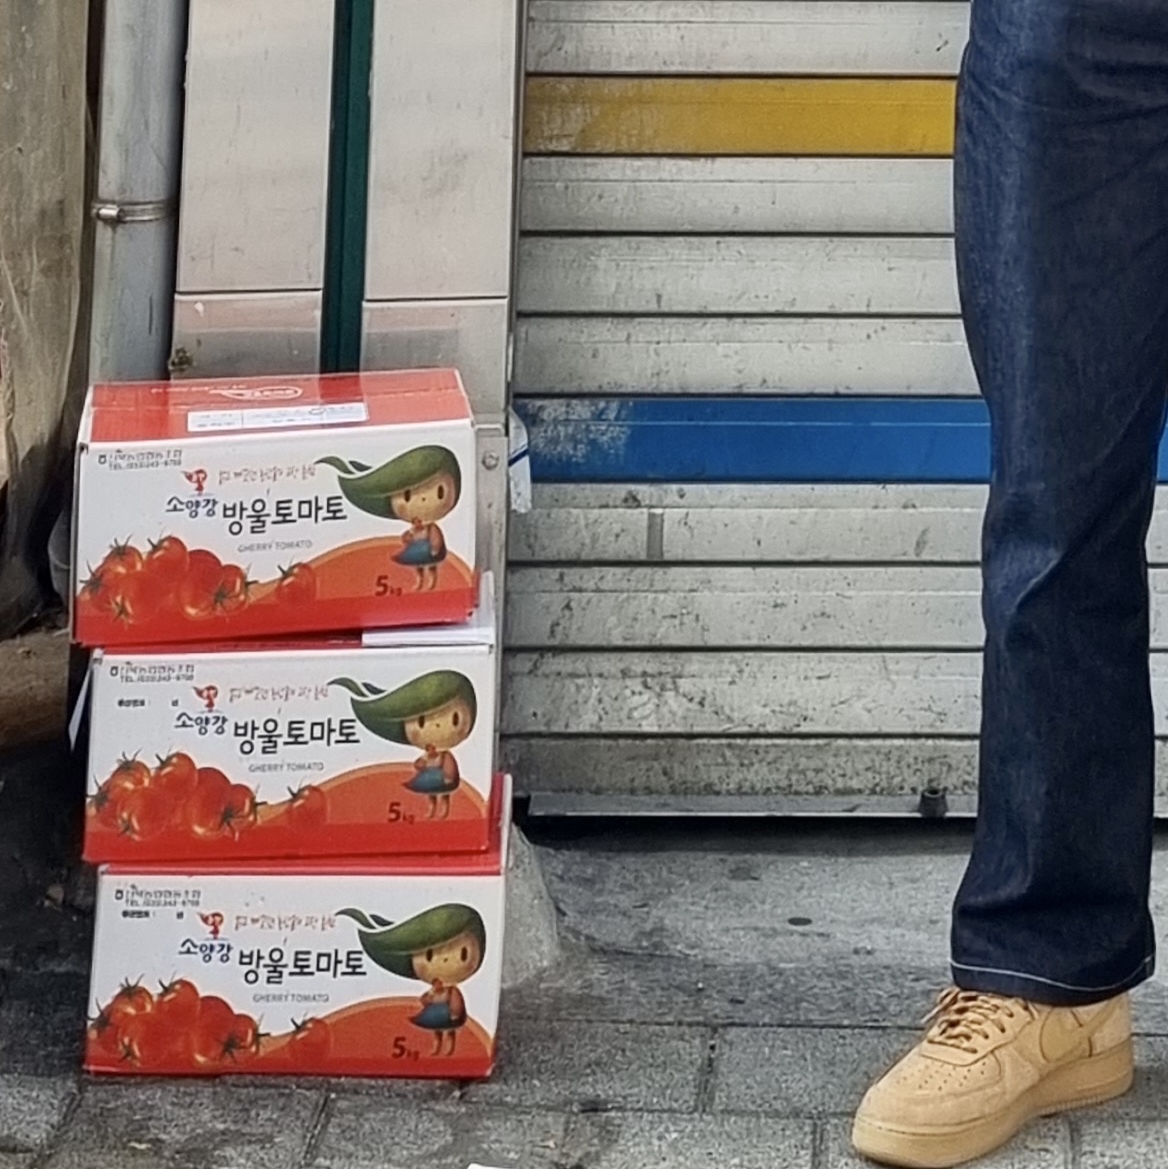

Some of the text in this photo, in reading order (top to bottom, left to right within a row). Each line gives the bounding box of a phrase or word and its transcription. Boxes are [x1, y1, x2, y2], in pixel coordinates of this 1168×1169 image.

[165, 495, 348, 536] 소양강 방울토마토
[174, 712, 360, 755] 소양강 방울토마토
[178, 938, 367, 985] 소양강 방울토마토
